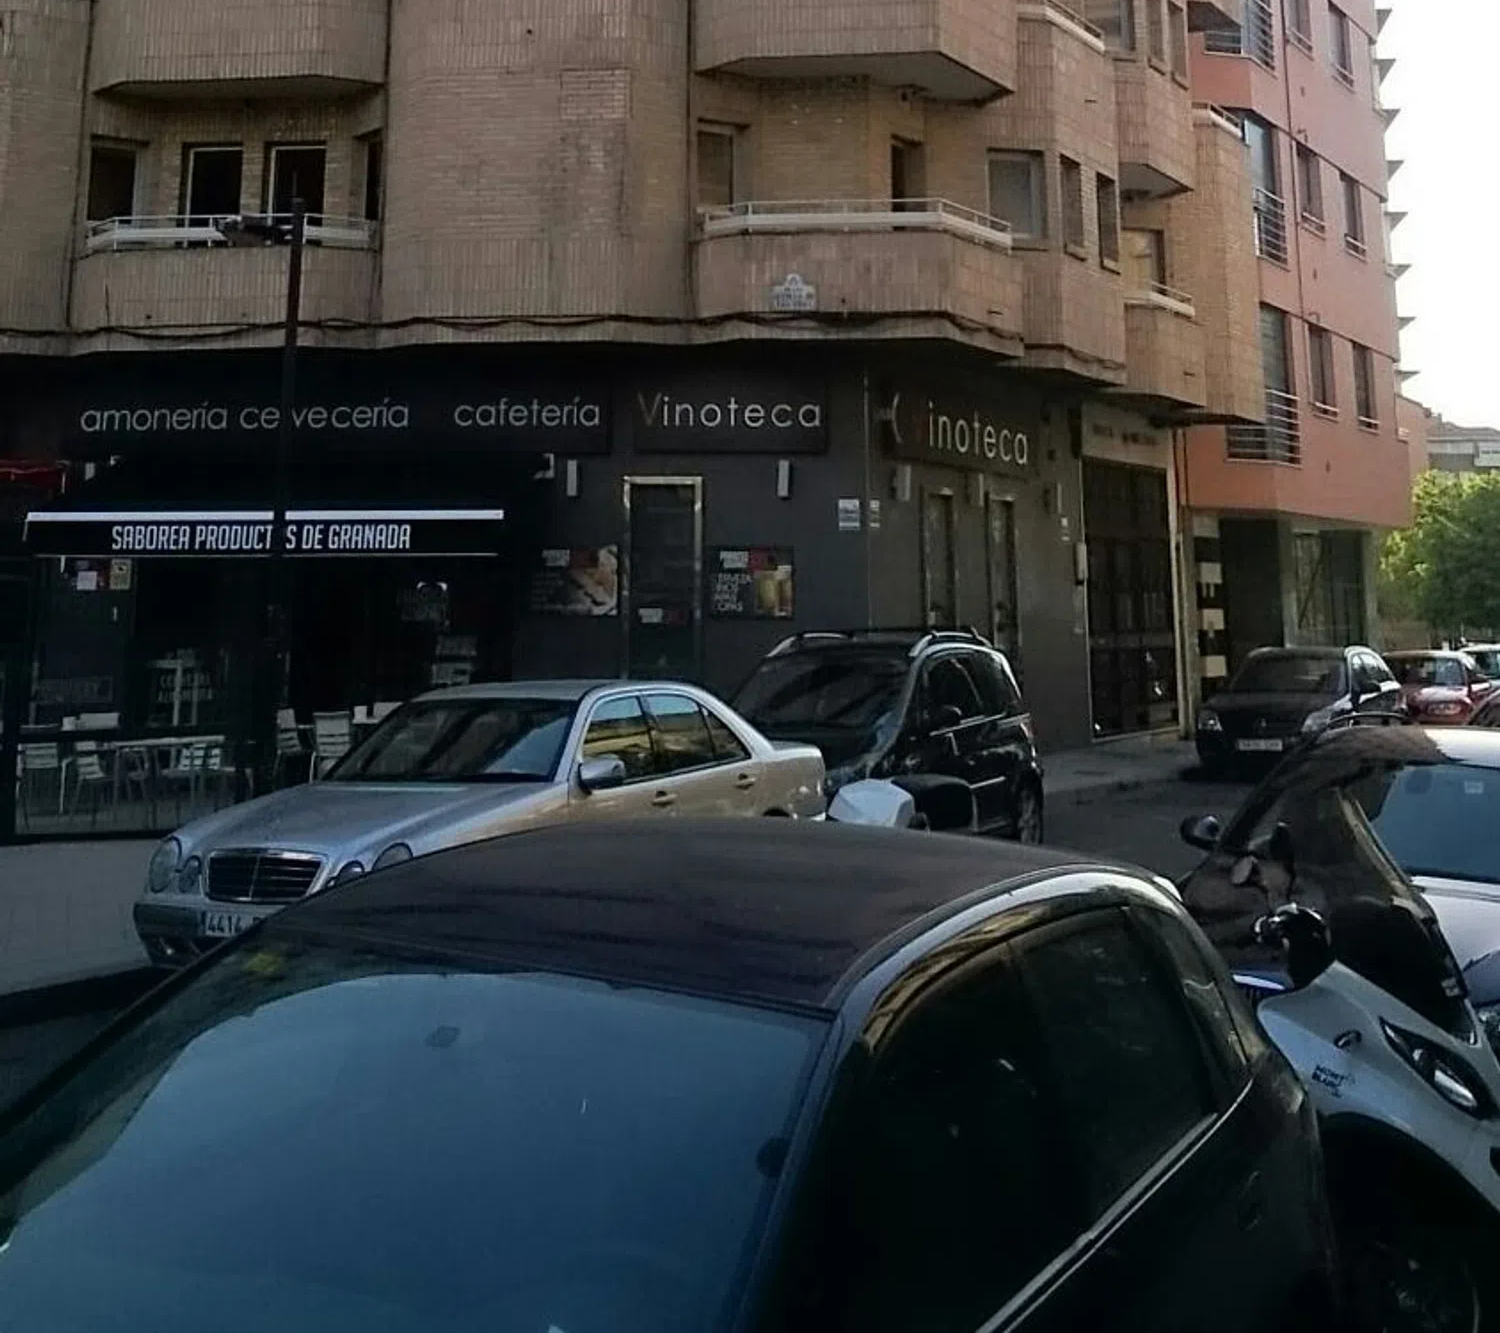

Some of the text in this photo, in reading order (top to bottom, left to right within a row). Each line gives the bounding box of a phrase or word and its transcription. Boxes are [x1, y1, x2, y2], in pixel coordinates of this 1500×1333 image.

[239, 397, 409, 430] cevecería
[454, 396, 601, 428] cafetería
[636, 391, 822, 428] Vinoteca
[907, 393, 1029, 465] inoteca
[111, 524, 411, 551] SABOREA PRODUCTS DE GRANADA
